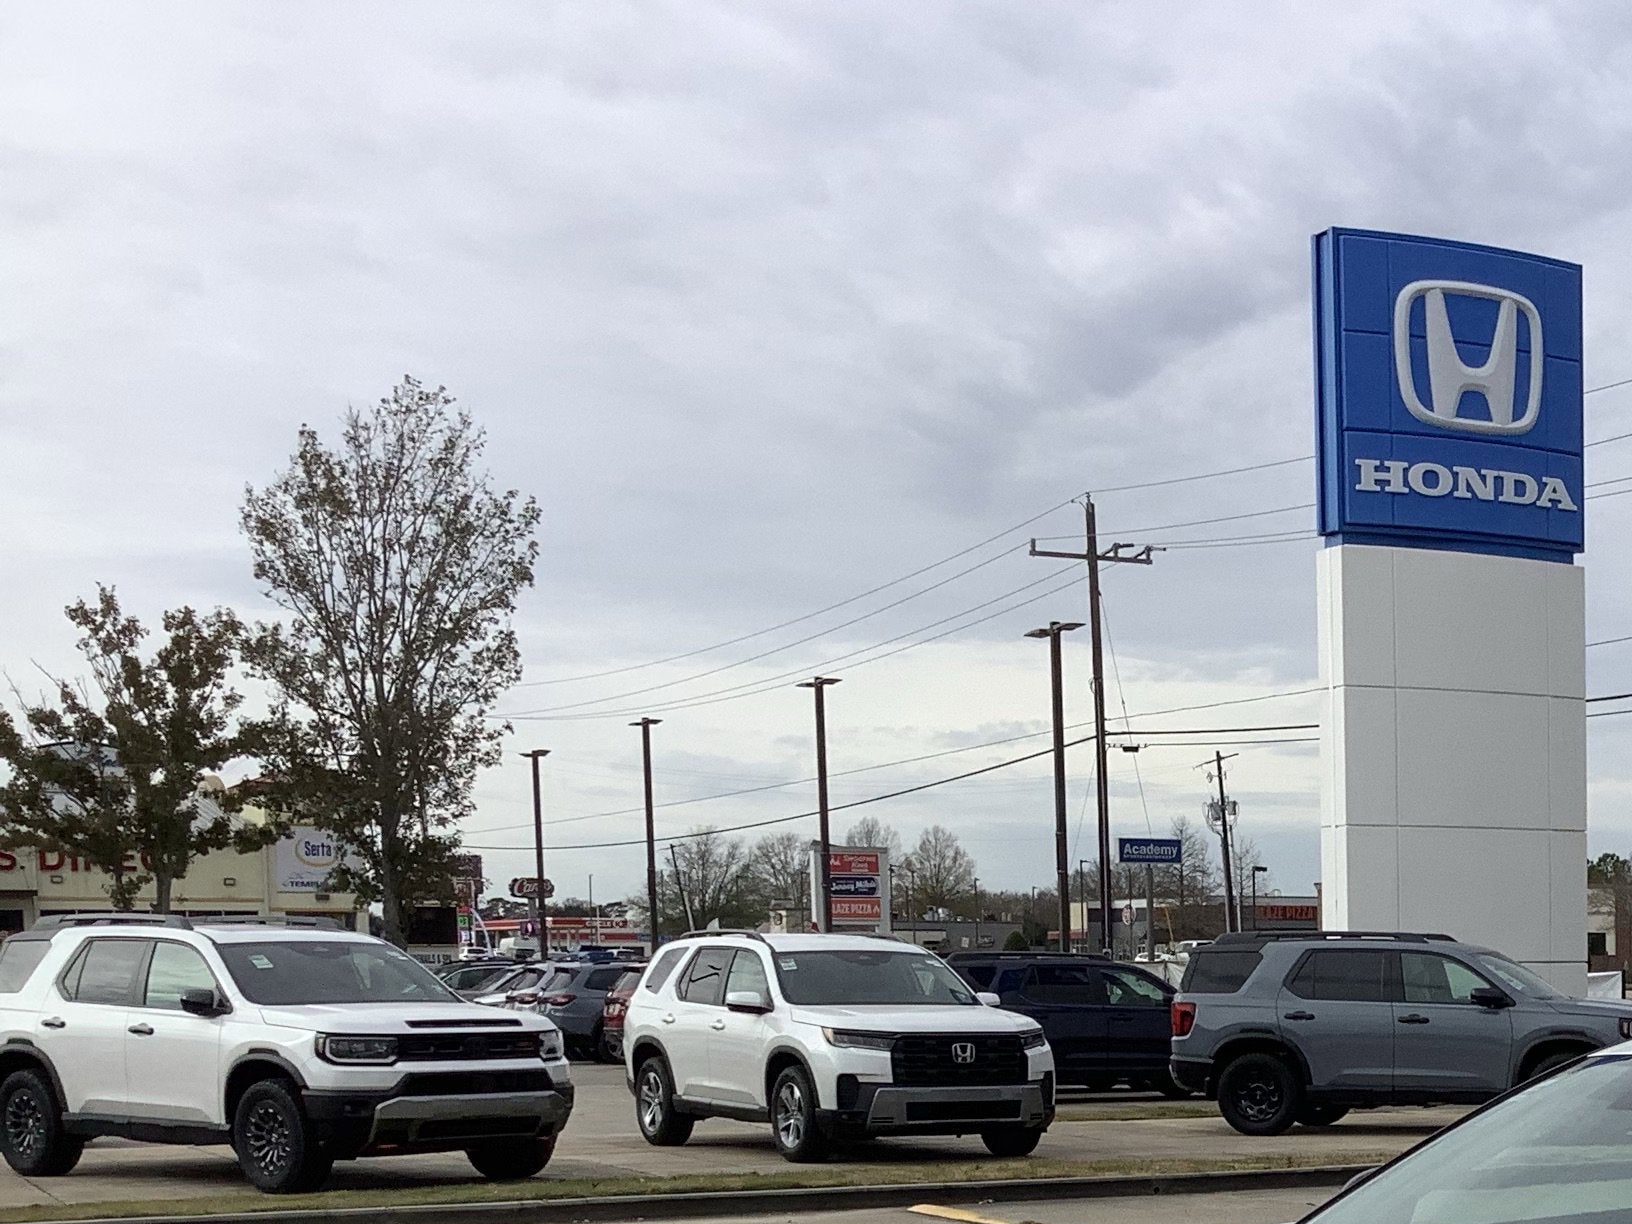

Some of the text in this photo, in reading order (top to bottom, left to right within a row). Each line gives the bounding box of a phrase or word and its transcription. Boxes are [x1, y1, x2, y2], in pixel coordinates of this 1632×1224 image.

[1355, 458, 1578, 511] HONDA
[304, 841, 332, 856] Serta
[1123, 843, 1178, 858] Academy
